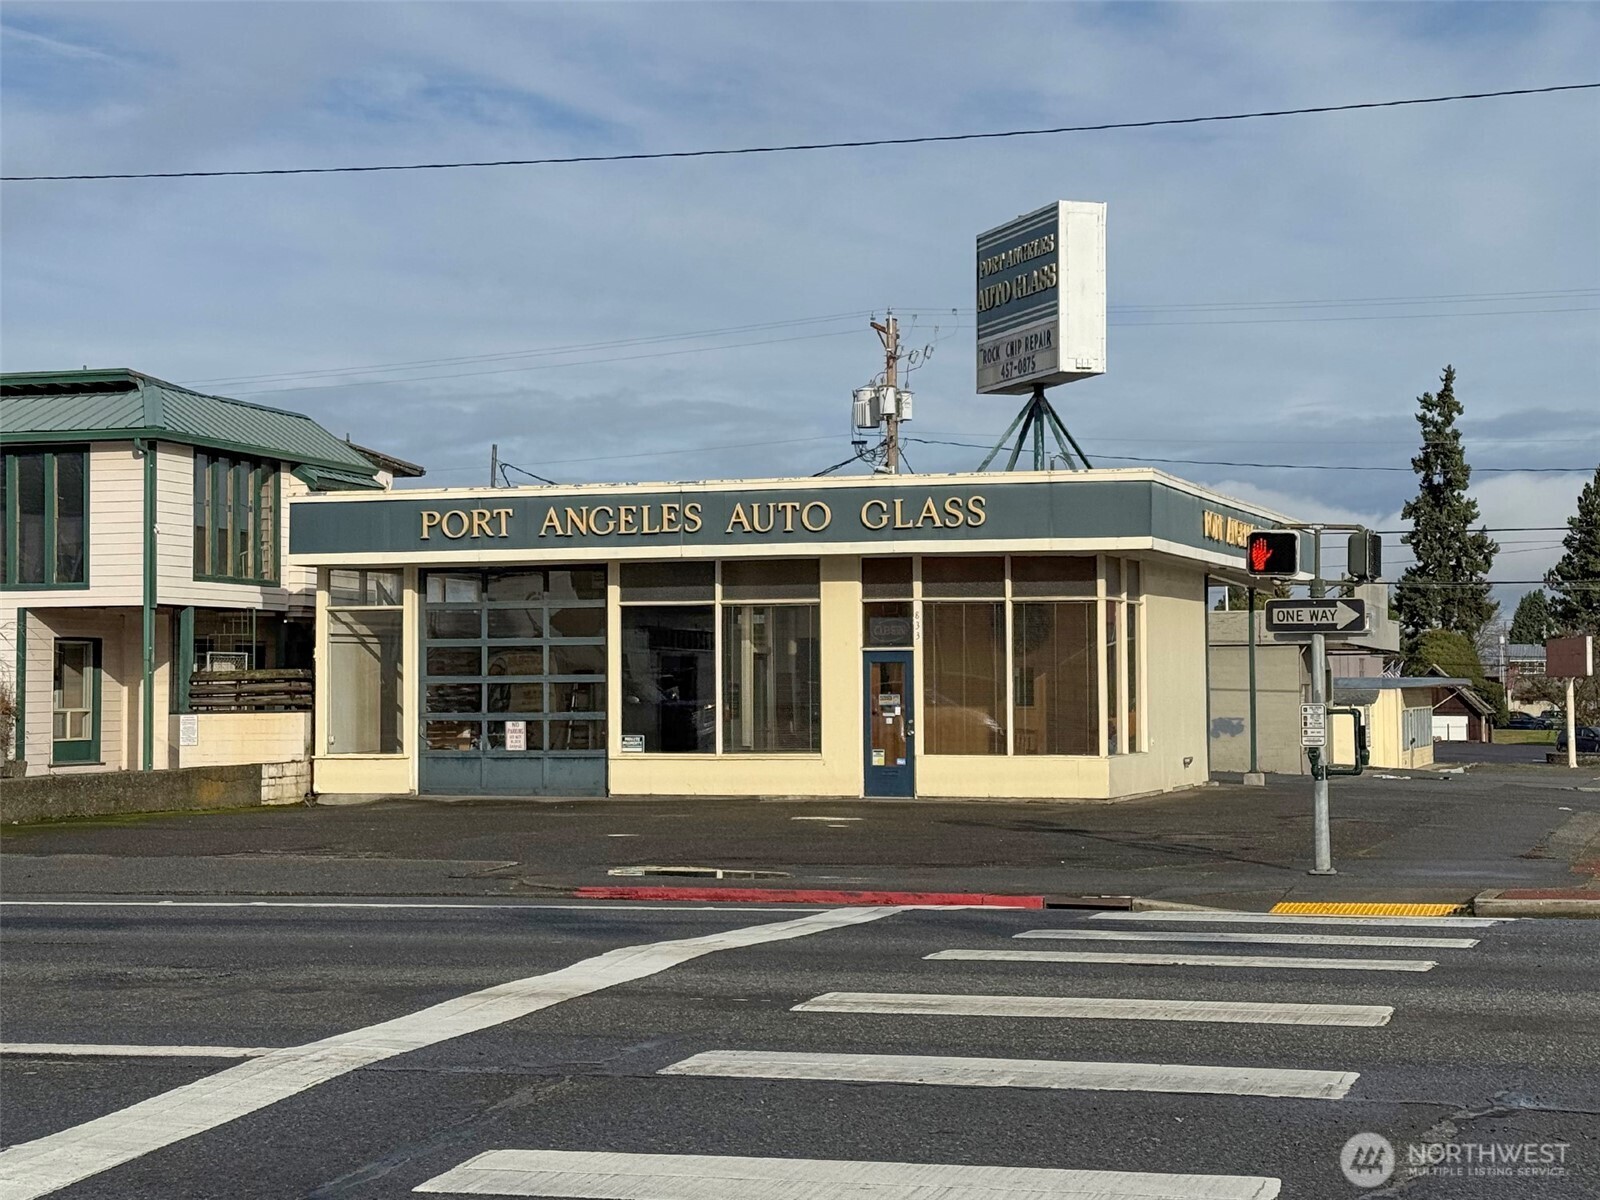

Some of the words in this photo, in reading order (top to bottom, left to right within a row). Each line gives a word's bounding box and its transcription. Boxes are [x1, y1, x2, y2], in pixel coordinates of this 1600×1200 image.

[980, 252, 1005, 278] PORT
[1007, 233, 1055, 269] ANGELES
[978, 280, 1011, 313] AUTO
[1012, 263, 1057, 299] GLASS
[982, 345, 1000, 365] ROCK
[1006, 339, 1021, 358] CHIP
[1025, 329, 1052, 352] REPAIR
[1001, 354, 1036, 378] 457-0875
[420, 508, 513, 540] PORT
[539, 503, 702, 536] ANGELES
[725, 501, 832, 533] AUTO
[860, 496, 986, 529] GLASS
[1276, 610, 1304, 622] ONE
[1309, 609, 1337, 622] WAY
